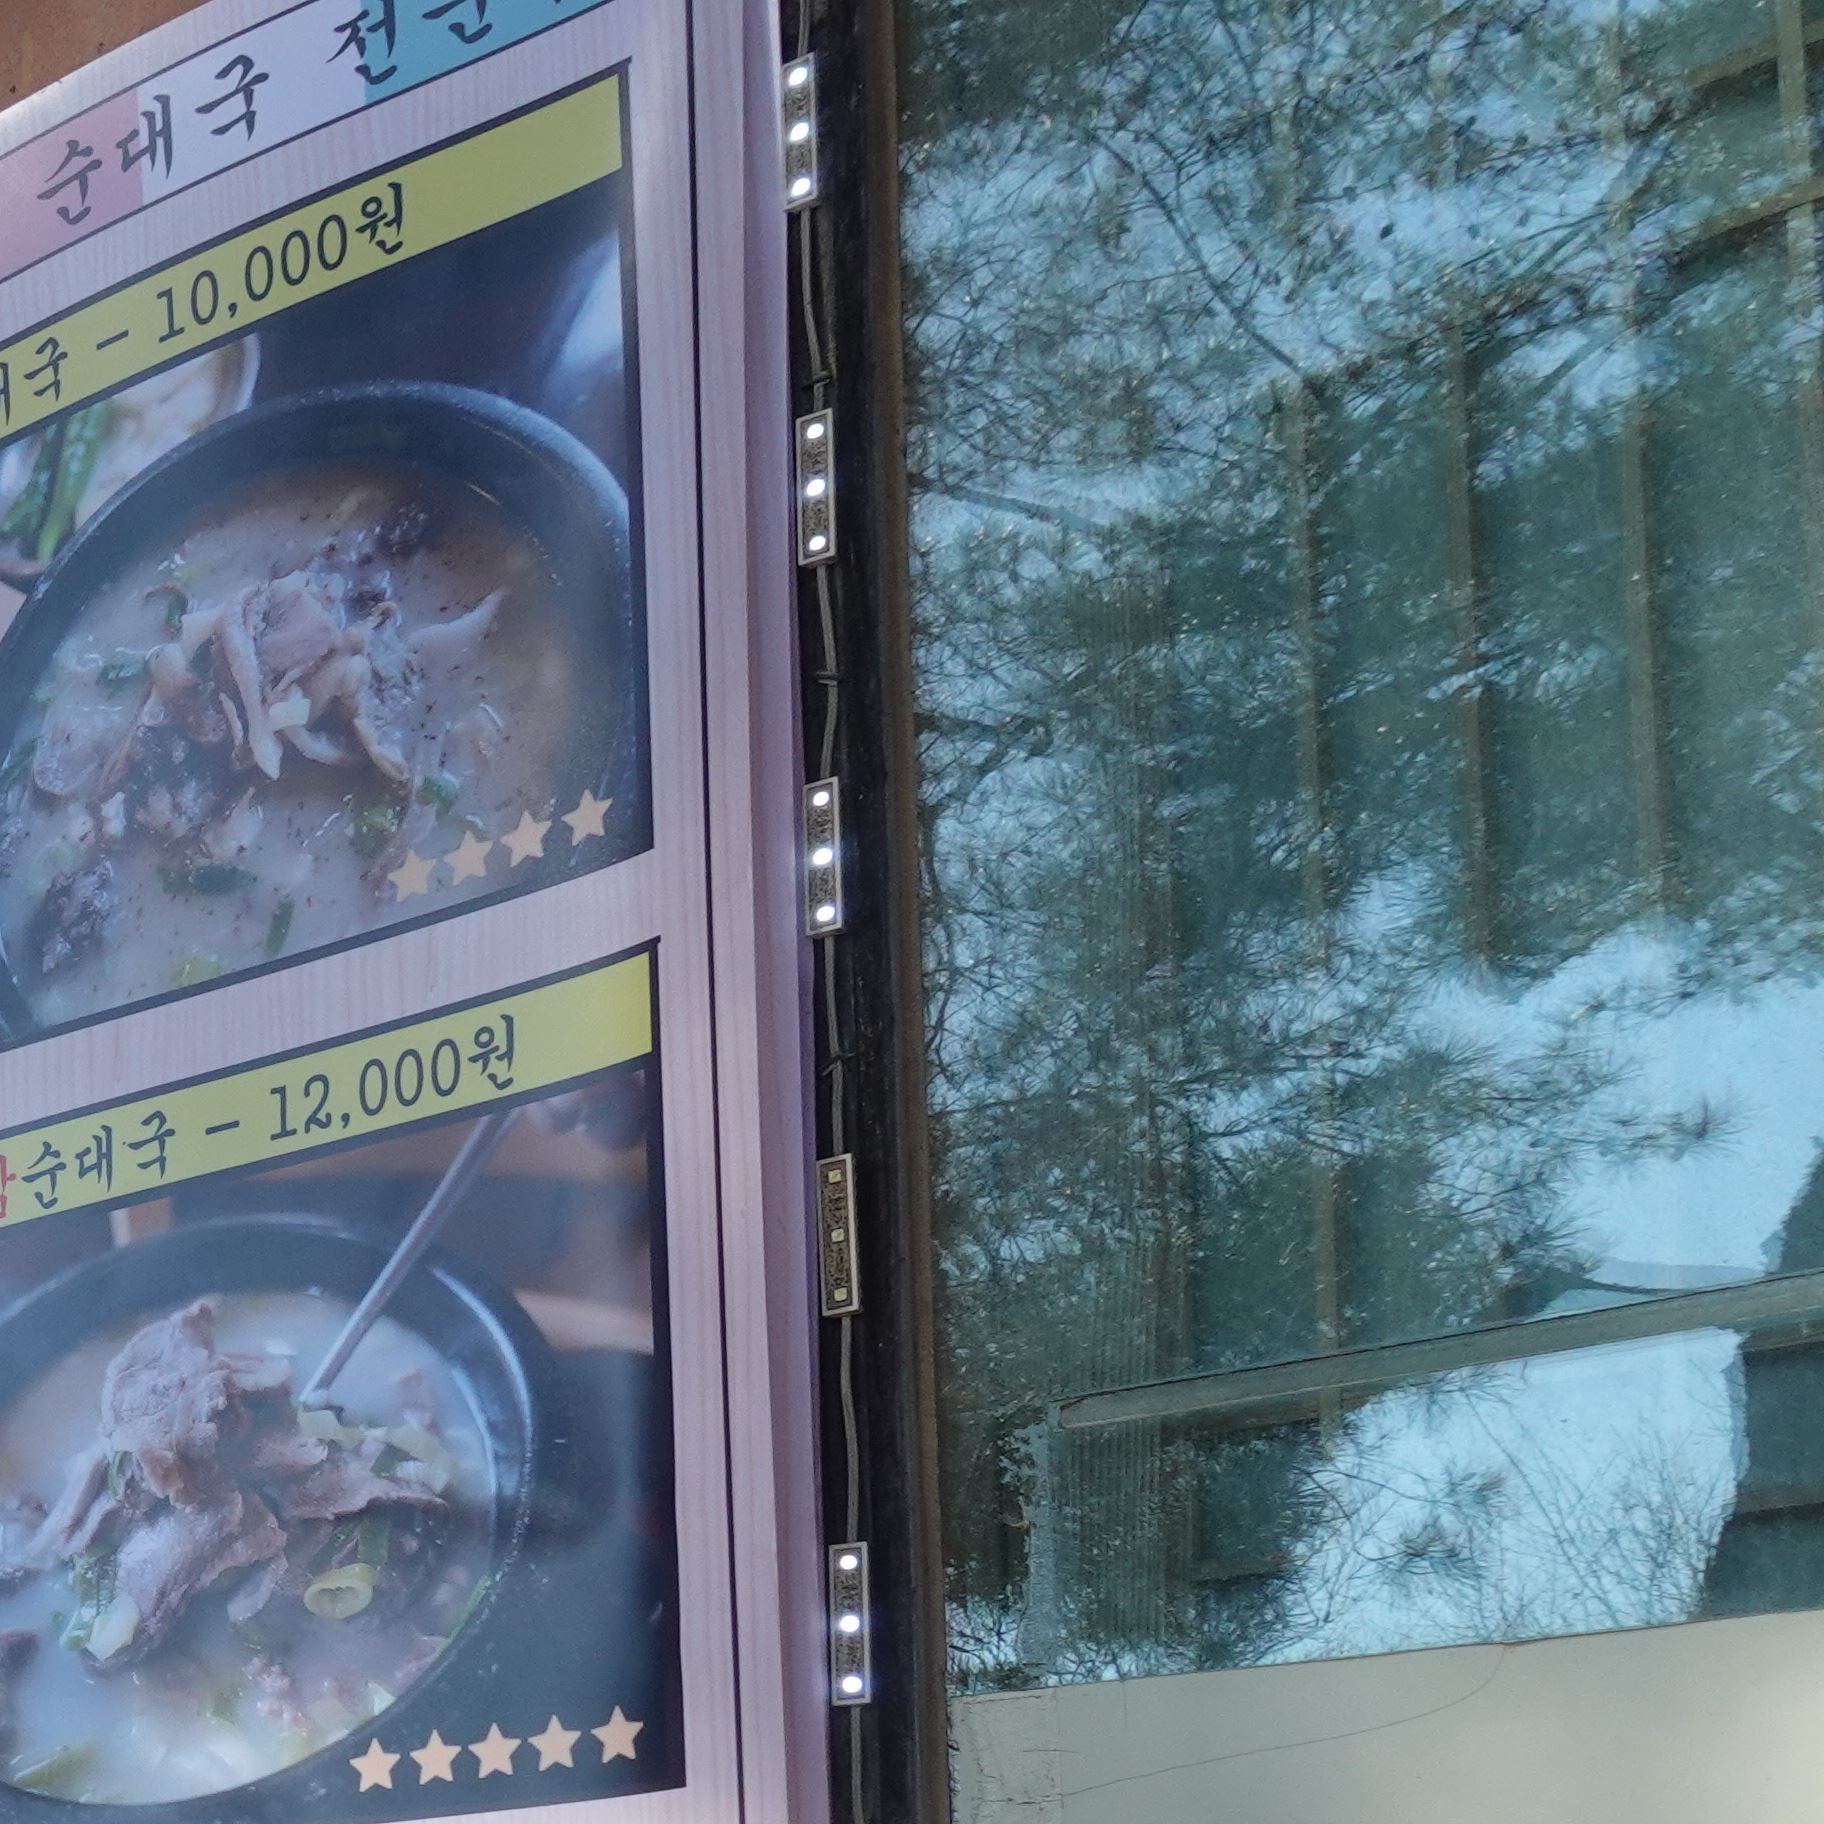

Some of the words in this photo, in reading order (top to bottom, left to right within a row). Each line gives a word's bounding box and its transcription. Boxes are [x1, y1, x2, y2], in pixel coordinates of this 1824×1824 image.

[35, 54, 270, 226] 순대국
[156, 179, 407, 343] 10,000원
[270, 1013, 517, 1142] 12,000원
